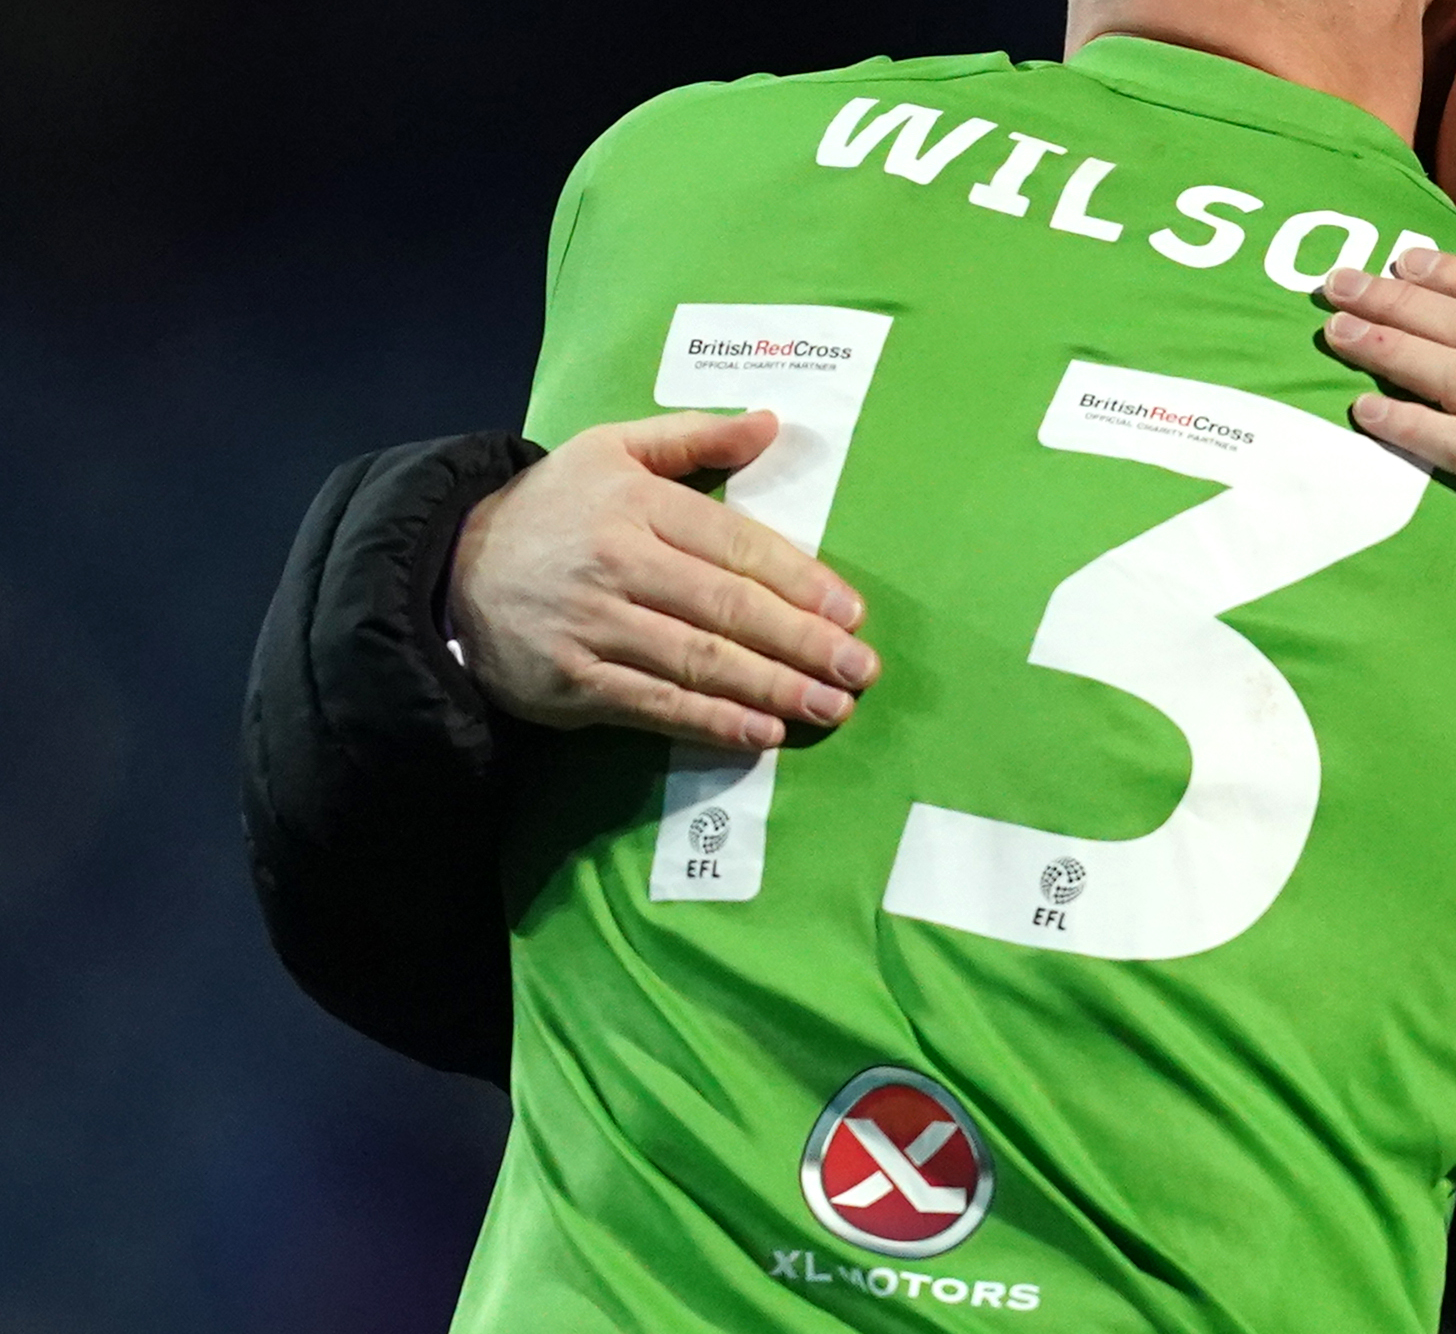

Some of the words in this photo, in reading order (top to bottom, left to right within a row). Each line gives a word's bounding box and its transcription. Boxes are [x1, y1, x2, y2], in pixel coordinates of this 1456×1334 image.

[648, 303, 1433, 961] 13
[687, 859, 721, 879] EFL
[1032, 907, 1066, 931] EFL
[770, 1249, 833, 1283] XL
